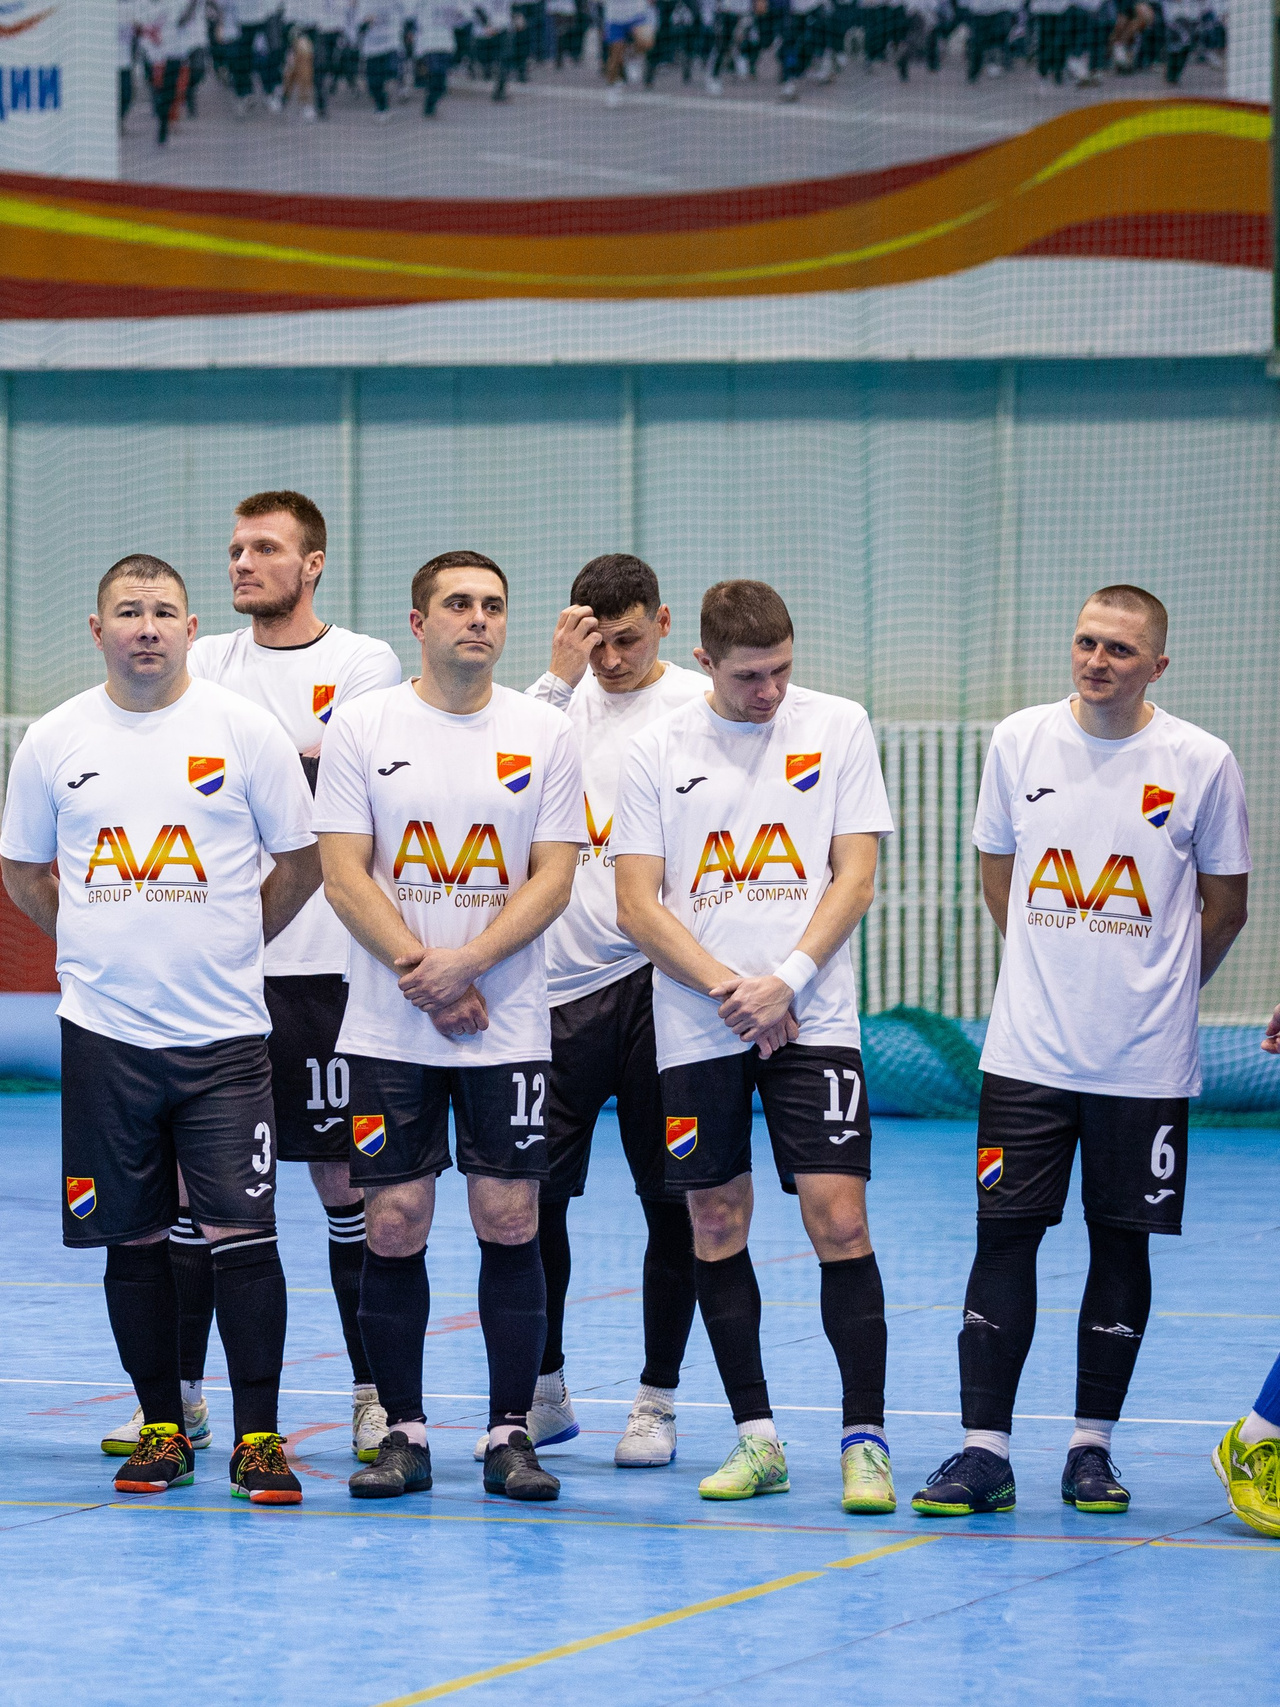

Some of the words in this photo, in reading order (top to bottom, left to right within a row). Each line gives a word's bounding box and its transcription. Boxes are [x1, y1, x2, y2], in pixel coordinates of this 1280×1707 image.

[84, 824, 208, 883] AVA
[393, 820, 510, 885] AVA
[690, 823, 807, 894] AVA
[88, 888, 132, 904] GROUP
[145, 889, 209, 904] COMPANY
[397, 887, 442, 905] GROUP
[454, 893, 508, 909] COMPANY
[747, 888, 809, 902] COMPANY
[1028, 847, 1153, 918] AVA
[1027, 911, 1076, 930] GROUP
[1089, 919, 1153, 939] COMPANY
[306, 1057, 350, 1110] 10
[510, 1072, 546, 1126] 12
[823, 1069, 861, 1122] 17
[251, 1121, 271, 1175] 3
[1150, 1125, 1176, 1180] 6
